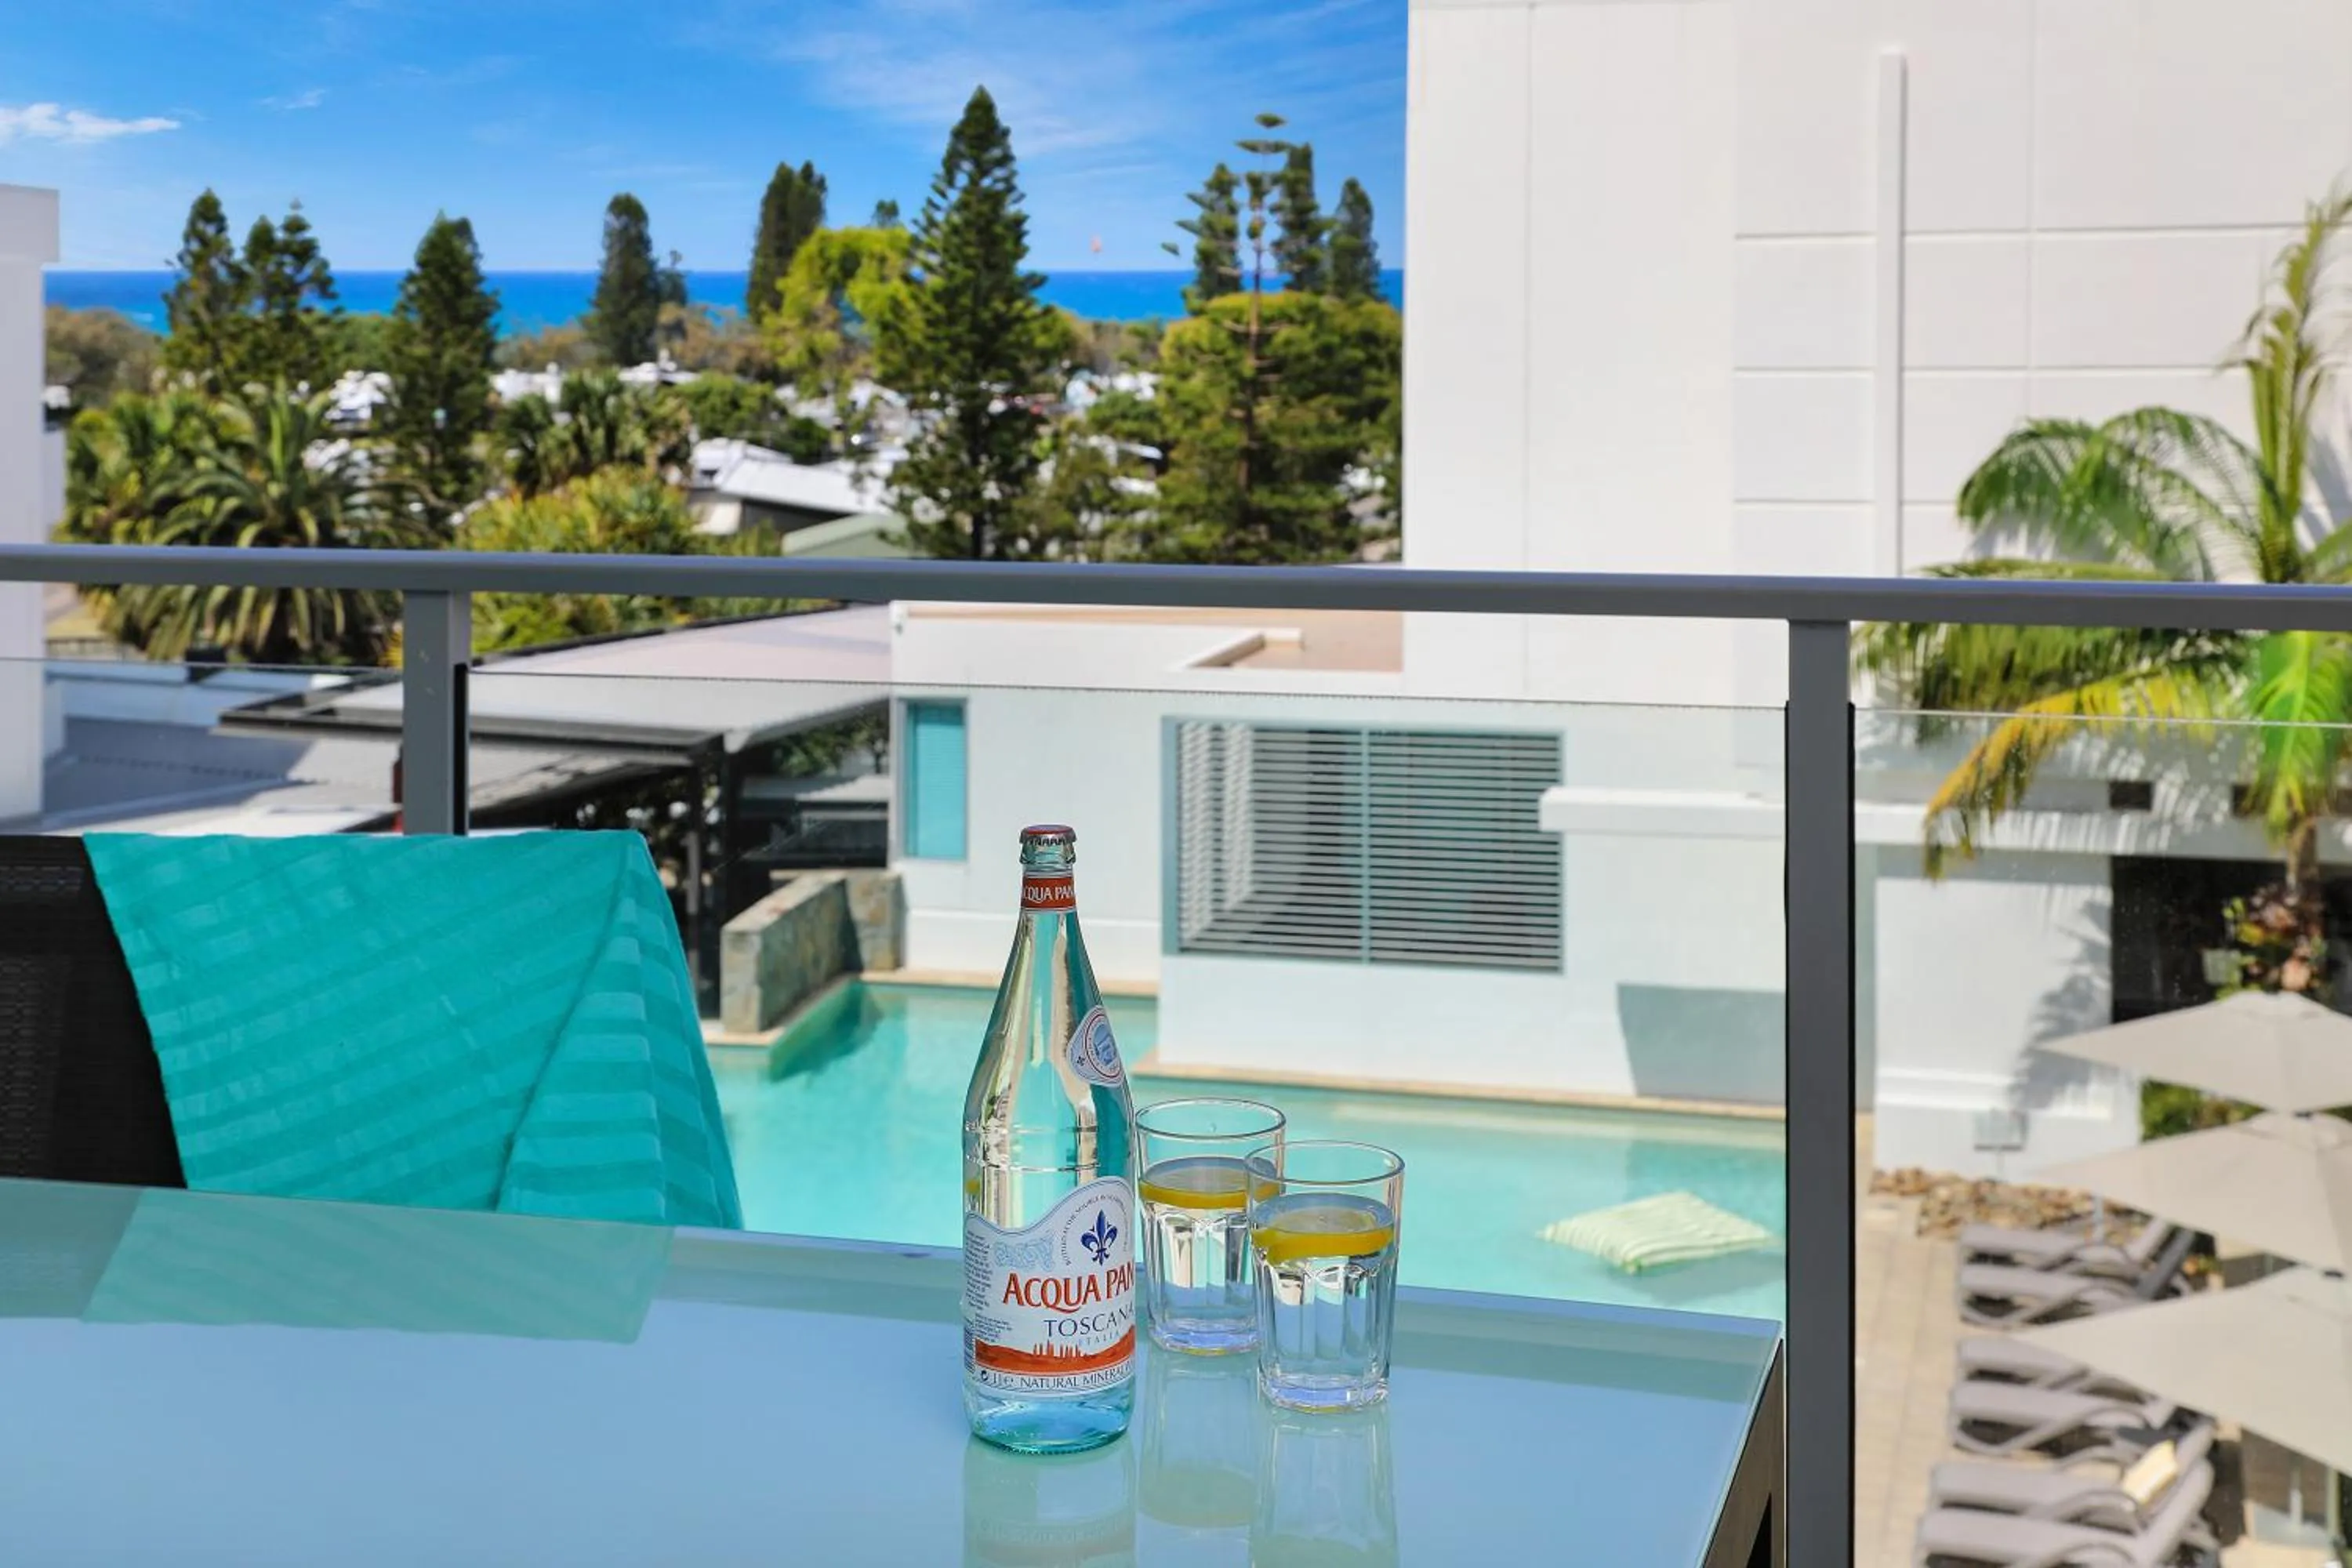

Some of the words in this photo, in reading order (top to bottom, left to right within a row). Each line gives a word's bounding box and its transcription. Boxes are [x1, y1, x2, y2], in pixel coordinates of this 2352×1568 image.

[1003, 1272, 1102, 1313] ACQUA
[1044, 1301, 1134, 1337] TOSCANA
[1021, 1376, 1079, 1388] NATURAL
